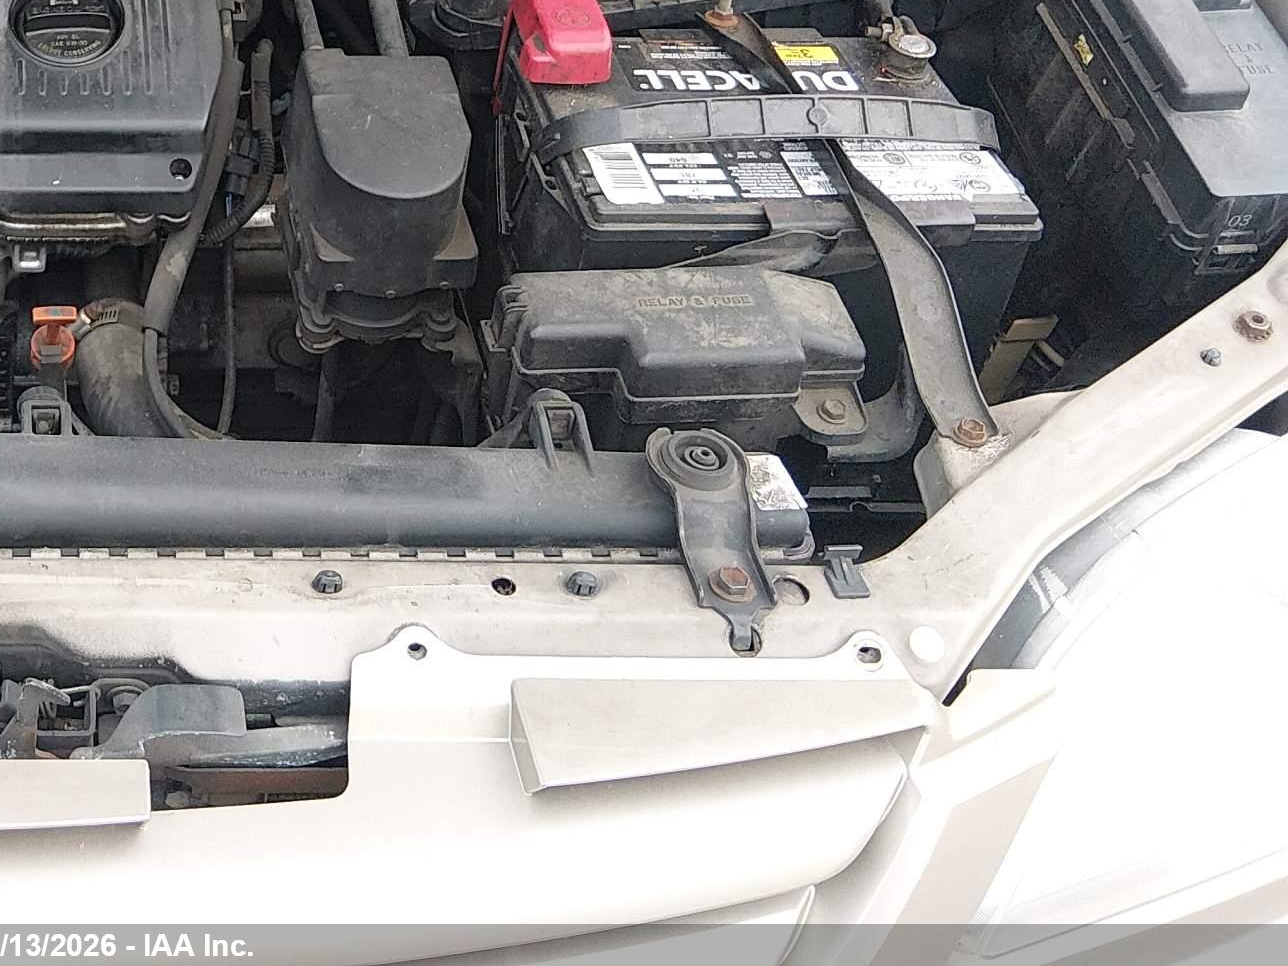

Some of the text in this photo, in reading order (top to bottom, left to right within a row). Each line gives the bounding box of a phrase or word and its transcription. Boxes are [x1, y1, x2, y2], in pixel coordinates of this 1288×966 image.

[632, 70, 860, 92] DUACELL
[1228, 215, 1252, 227] 03
[638, 295, 752, 307] RELAY & FUSE
